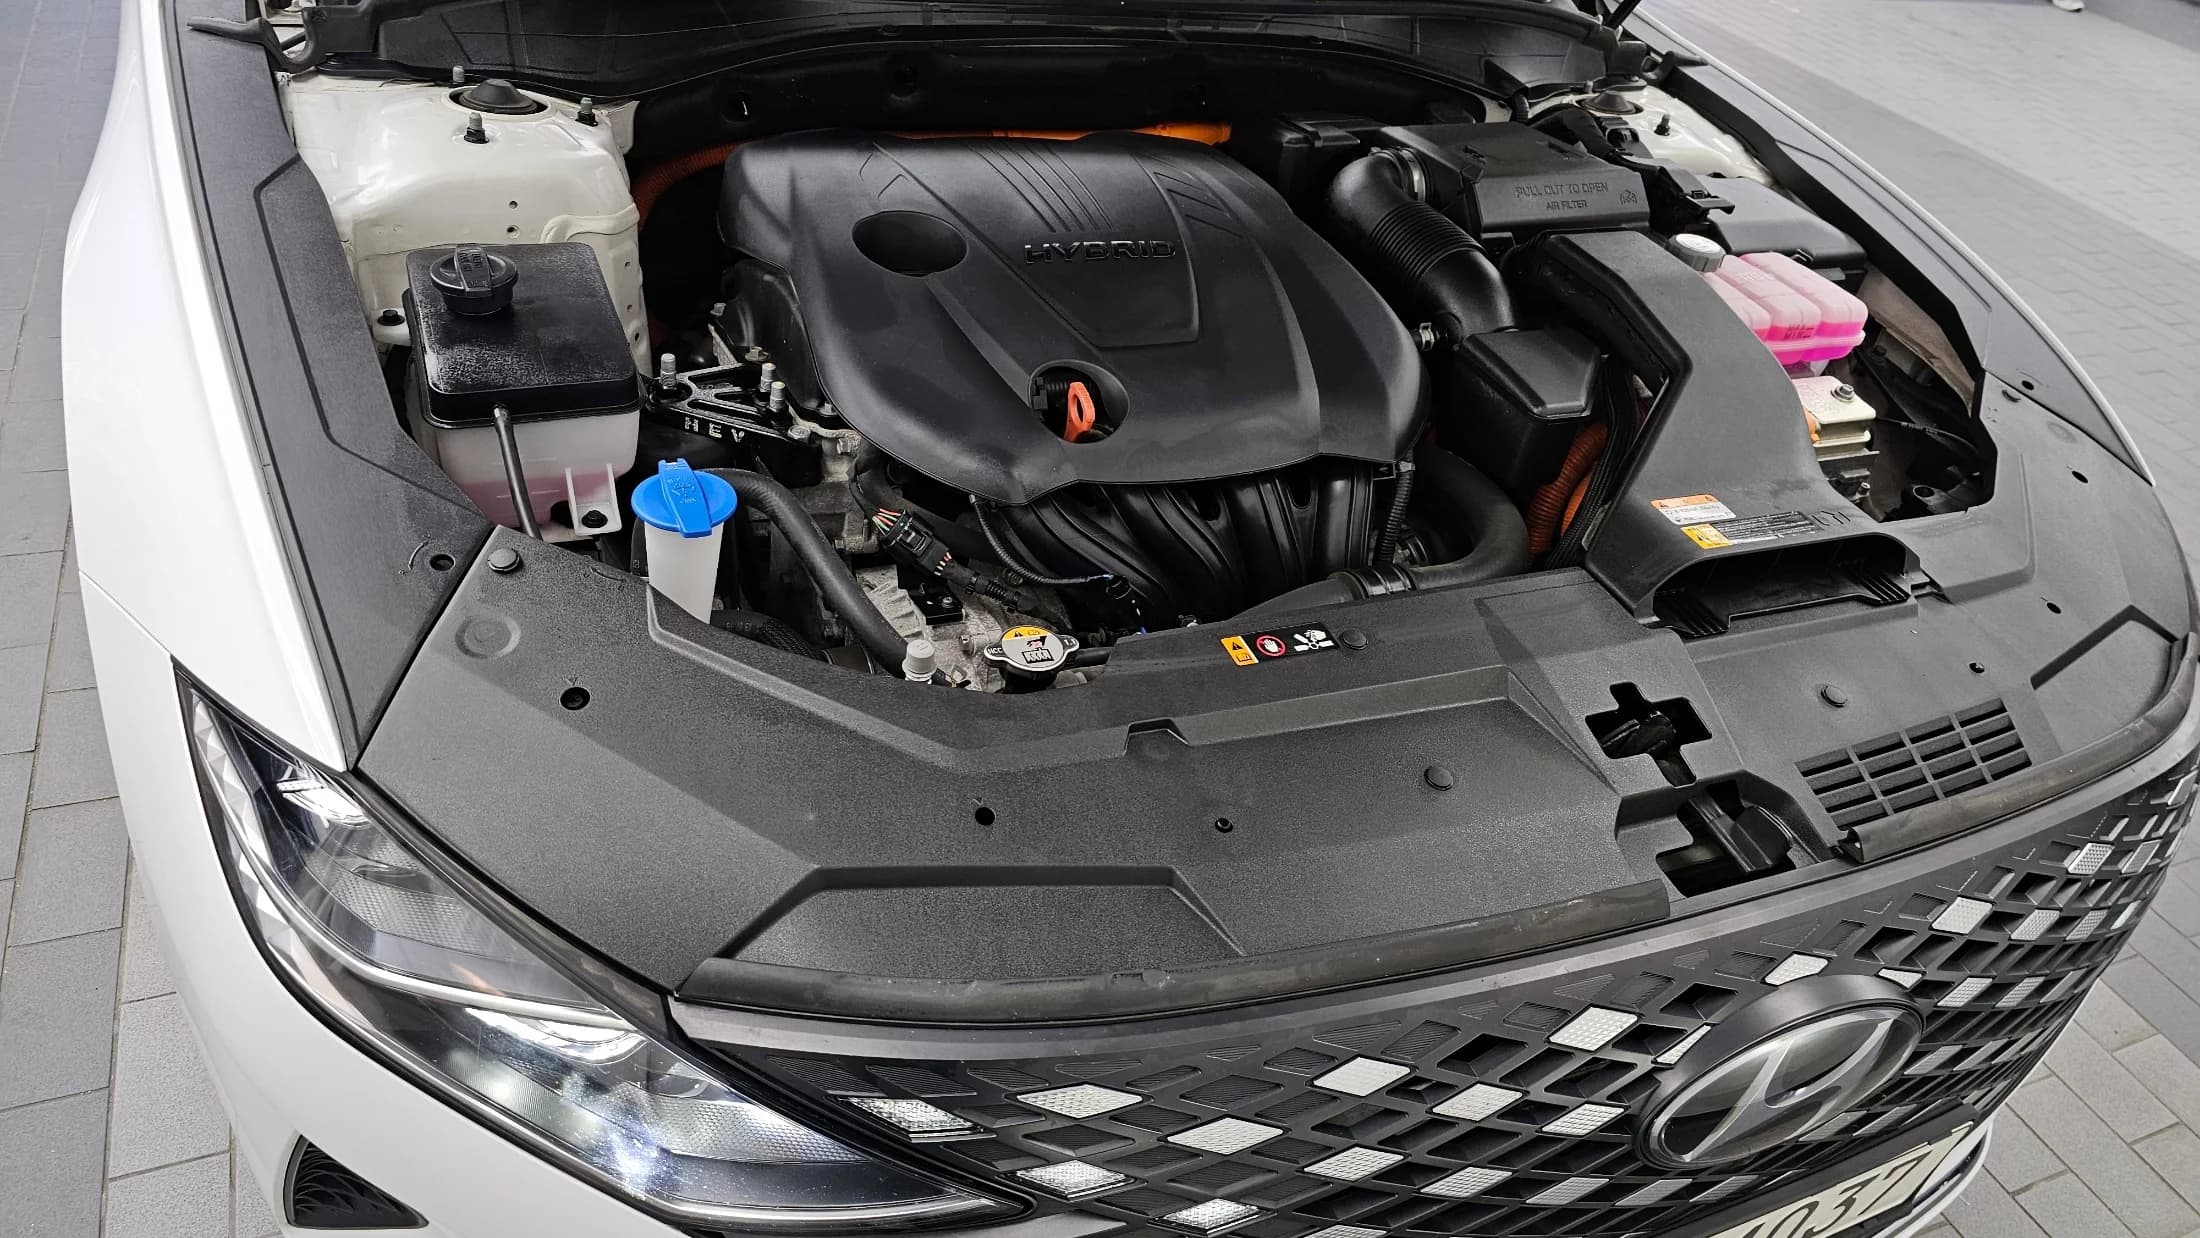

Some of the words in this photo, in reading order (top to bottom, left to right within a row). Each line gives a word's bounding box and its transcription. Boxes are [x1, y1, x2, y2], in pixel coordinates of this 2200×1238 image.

[1515, 185, 1542, 199] PULL
[1544, 184, 1563, 196] OUT
[1565, 183, 1580, 194] TO
[1582, 181, 1609, 193] OPEN
[1546, 201, 1560, 211] AIR
[1561, 199, 1588, 210] FILTER
[1024, 240, 1176, 264] HYBRID
[684, 416, 745, 443] HEV
[1741, 1149, 1925, 1238] 037
